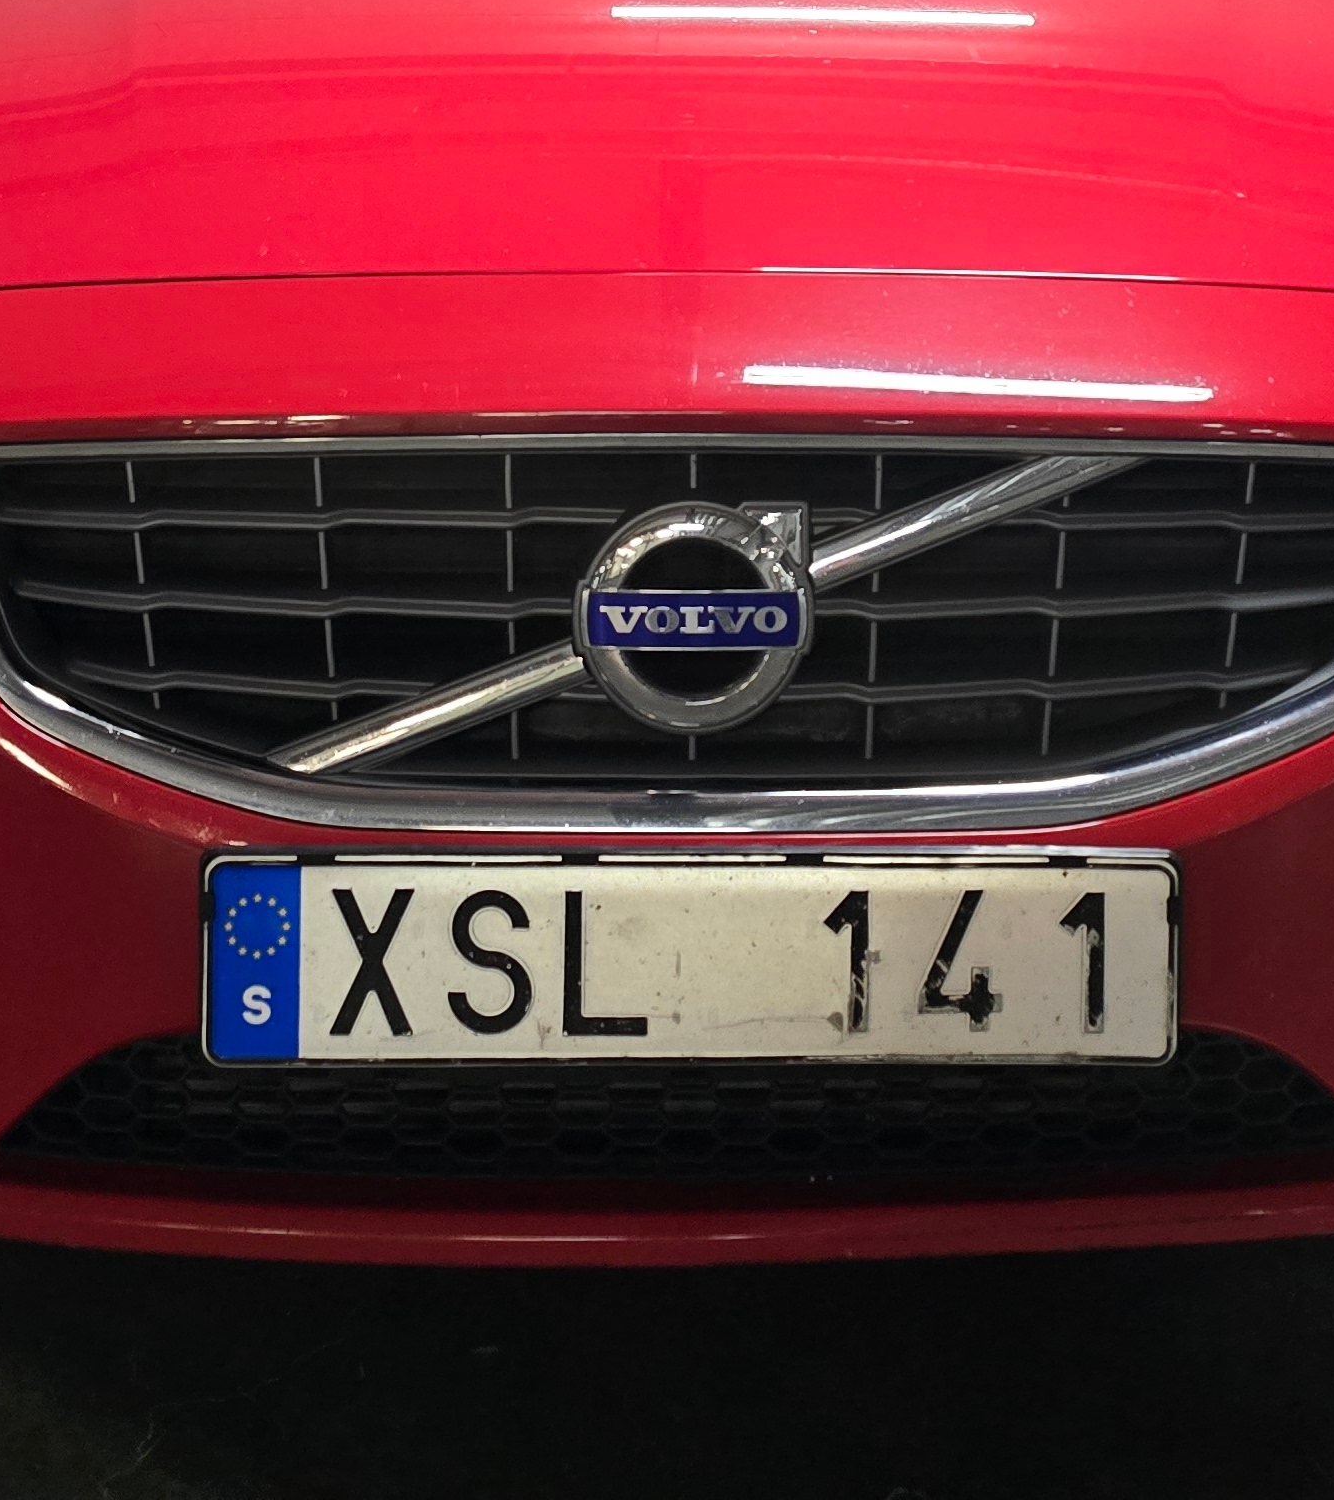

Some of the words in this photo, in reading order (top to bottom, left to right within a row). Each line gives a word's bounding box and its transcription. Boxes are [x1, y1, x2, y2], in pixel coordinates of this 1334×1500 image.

[599, 605, 788, 635] VOLVO
[329, 888, 649, 1036] XSL
[823, 889, 1107, 1035] 141
[240, 984, 272, 1026] S
